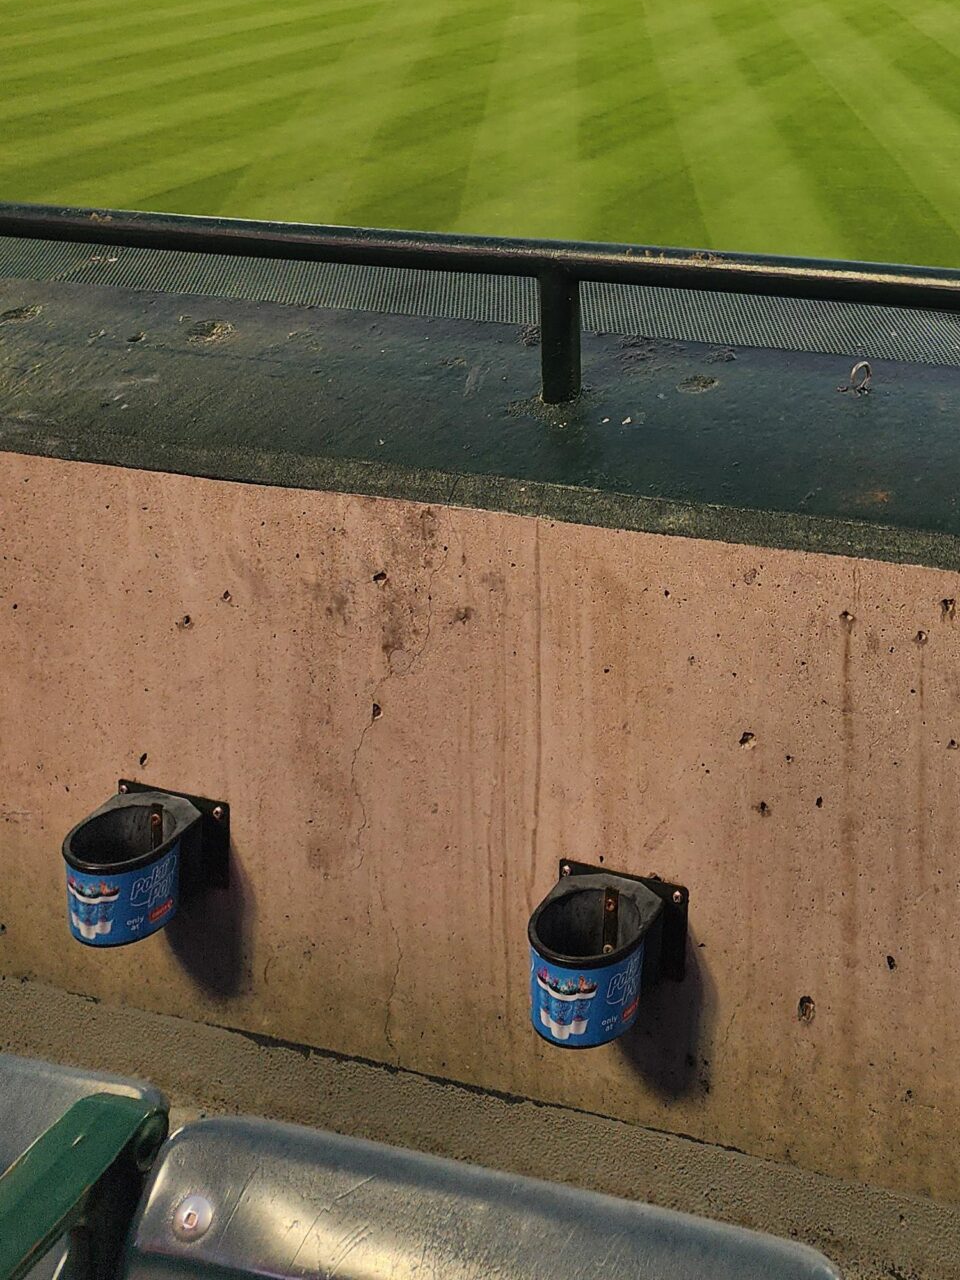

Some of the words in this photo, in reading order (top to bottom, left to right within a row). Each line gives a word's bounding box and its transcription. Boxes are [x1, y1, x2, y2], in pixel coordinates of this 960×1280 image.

[126, 915, 145, 926] only
[602, 1015, 618, 1026] only
[605, 1023, 613, 1032] at
